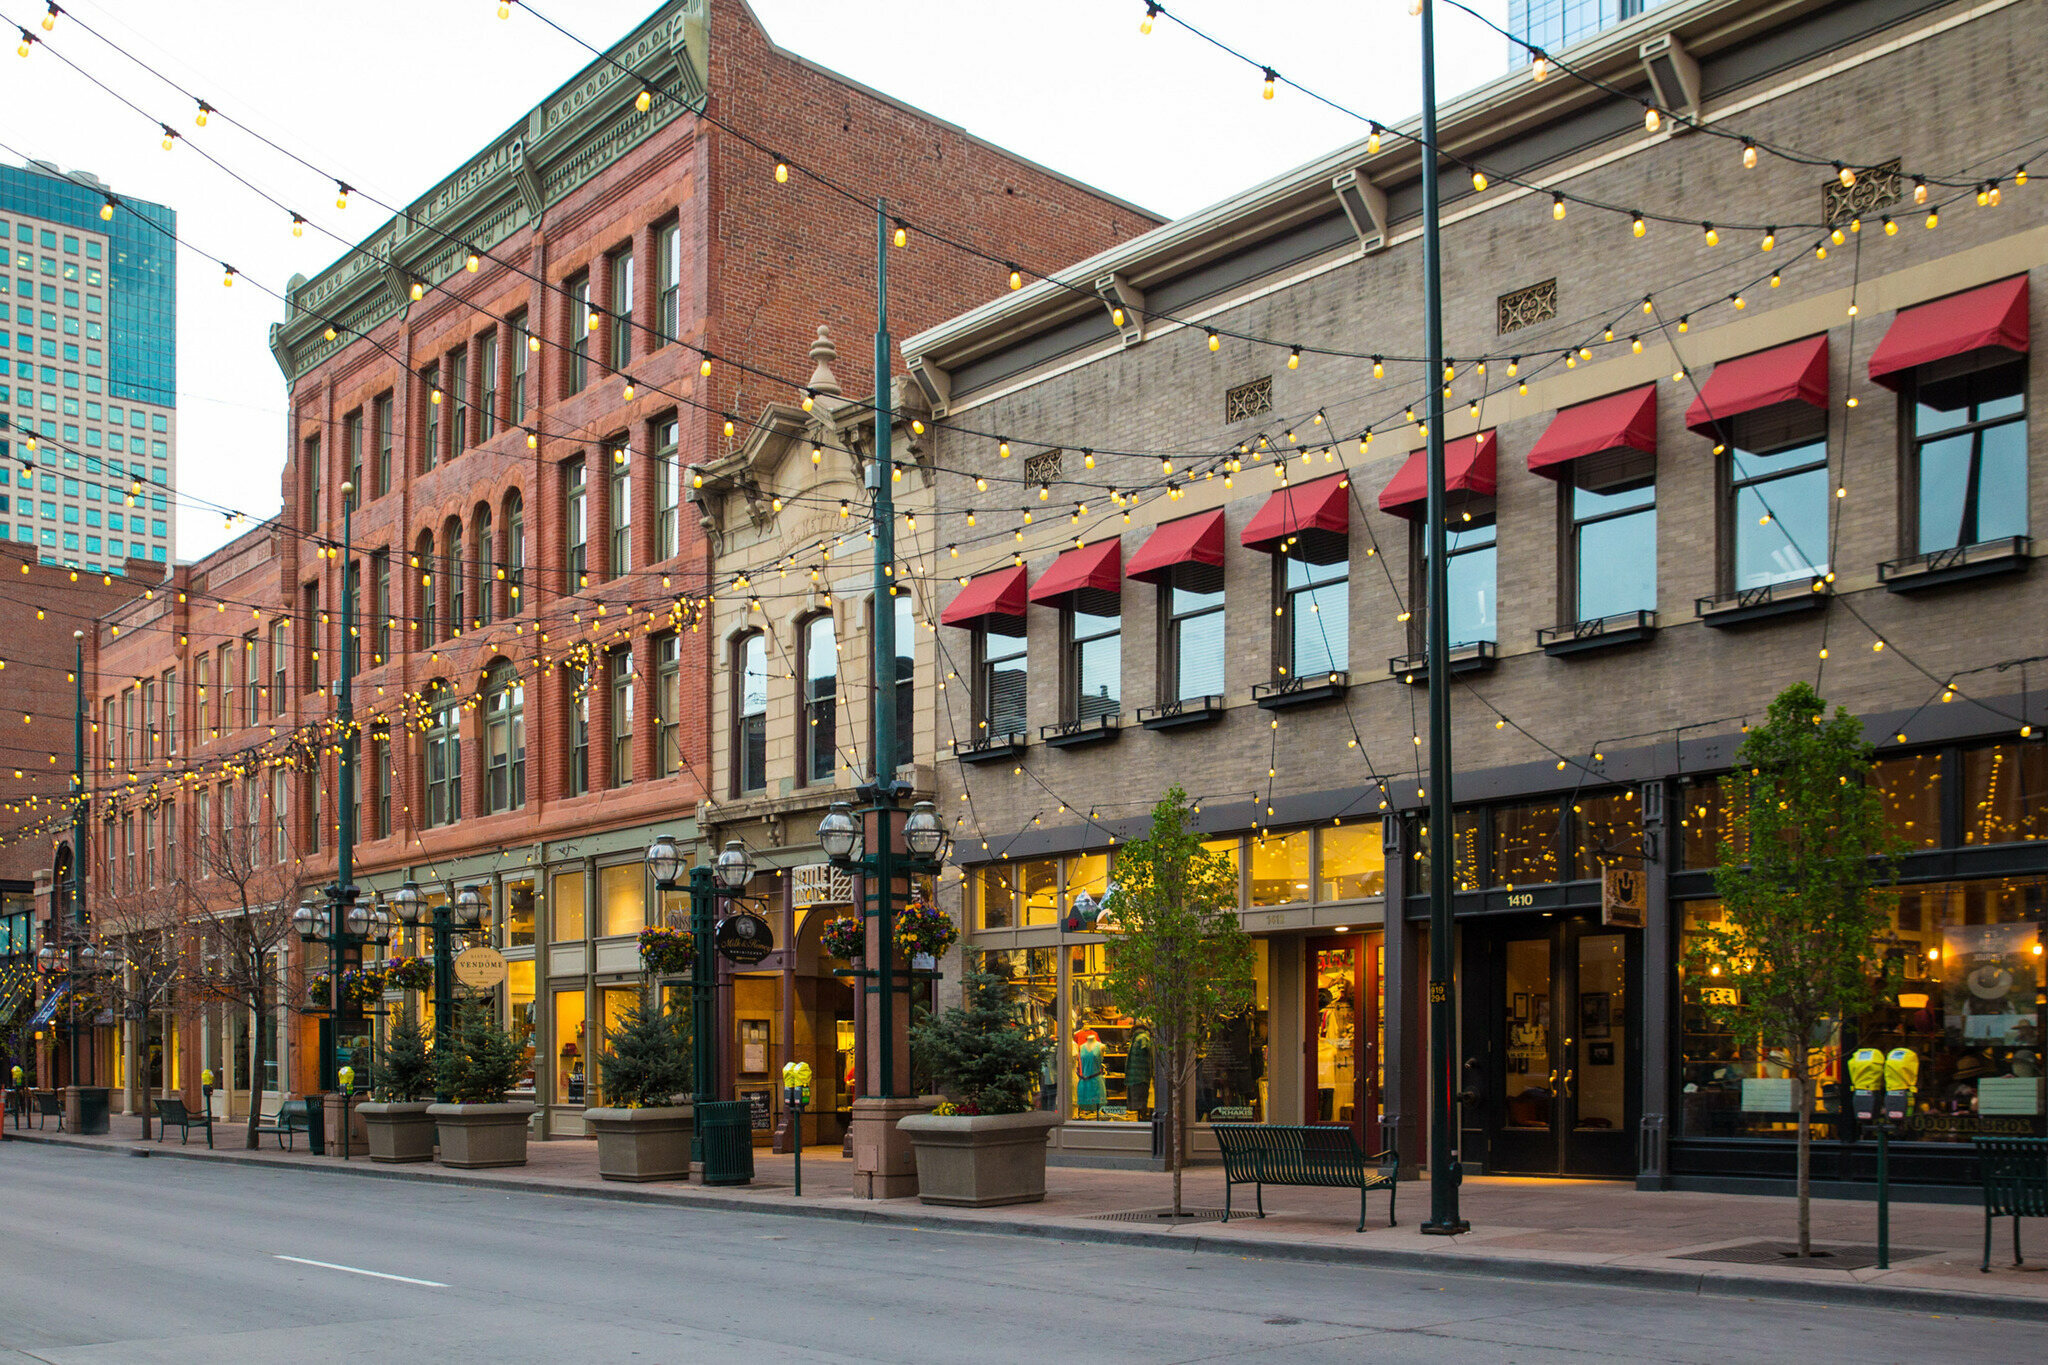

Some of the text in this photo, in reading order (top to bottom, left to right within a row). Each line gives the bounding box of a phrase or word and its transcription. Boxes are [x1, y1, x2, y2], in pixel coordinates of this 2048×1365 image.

[440, 150, 500, 209] SUSSEX
[1507, 894, 1533, 907] 1410
[721, 938, 740, 949] Milk
